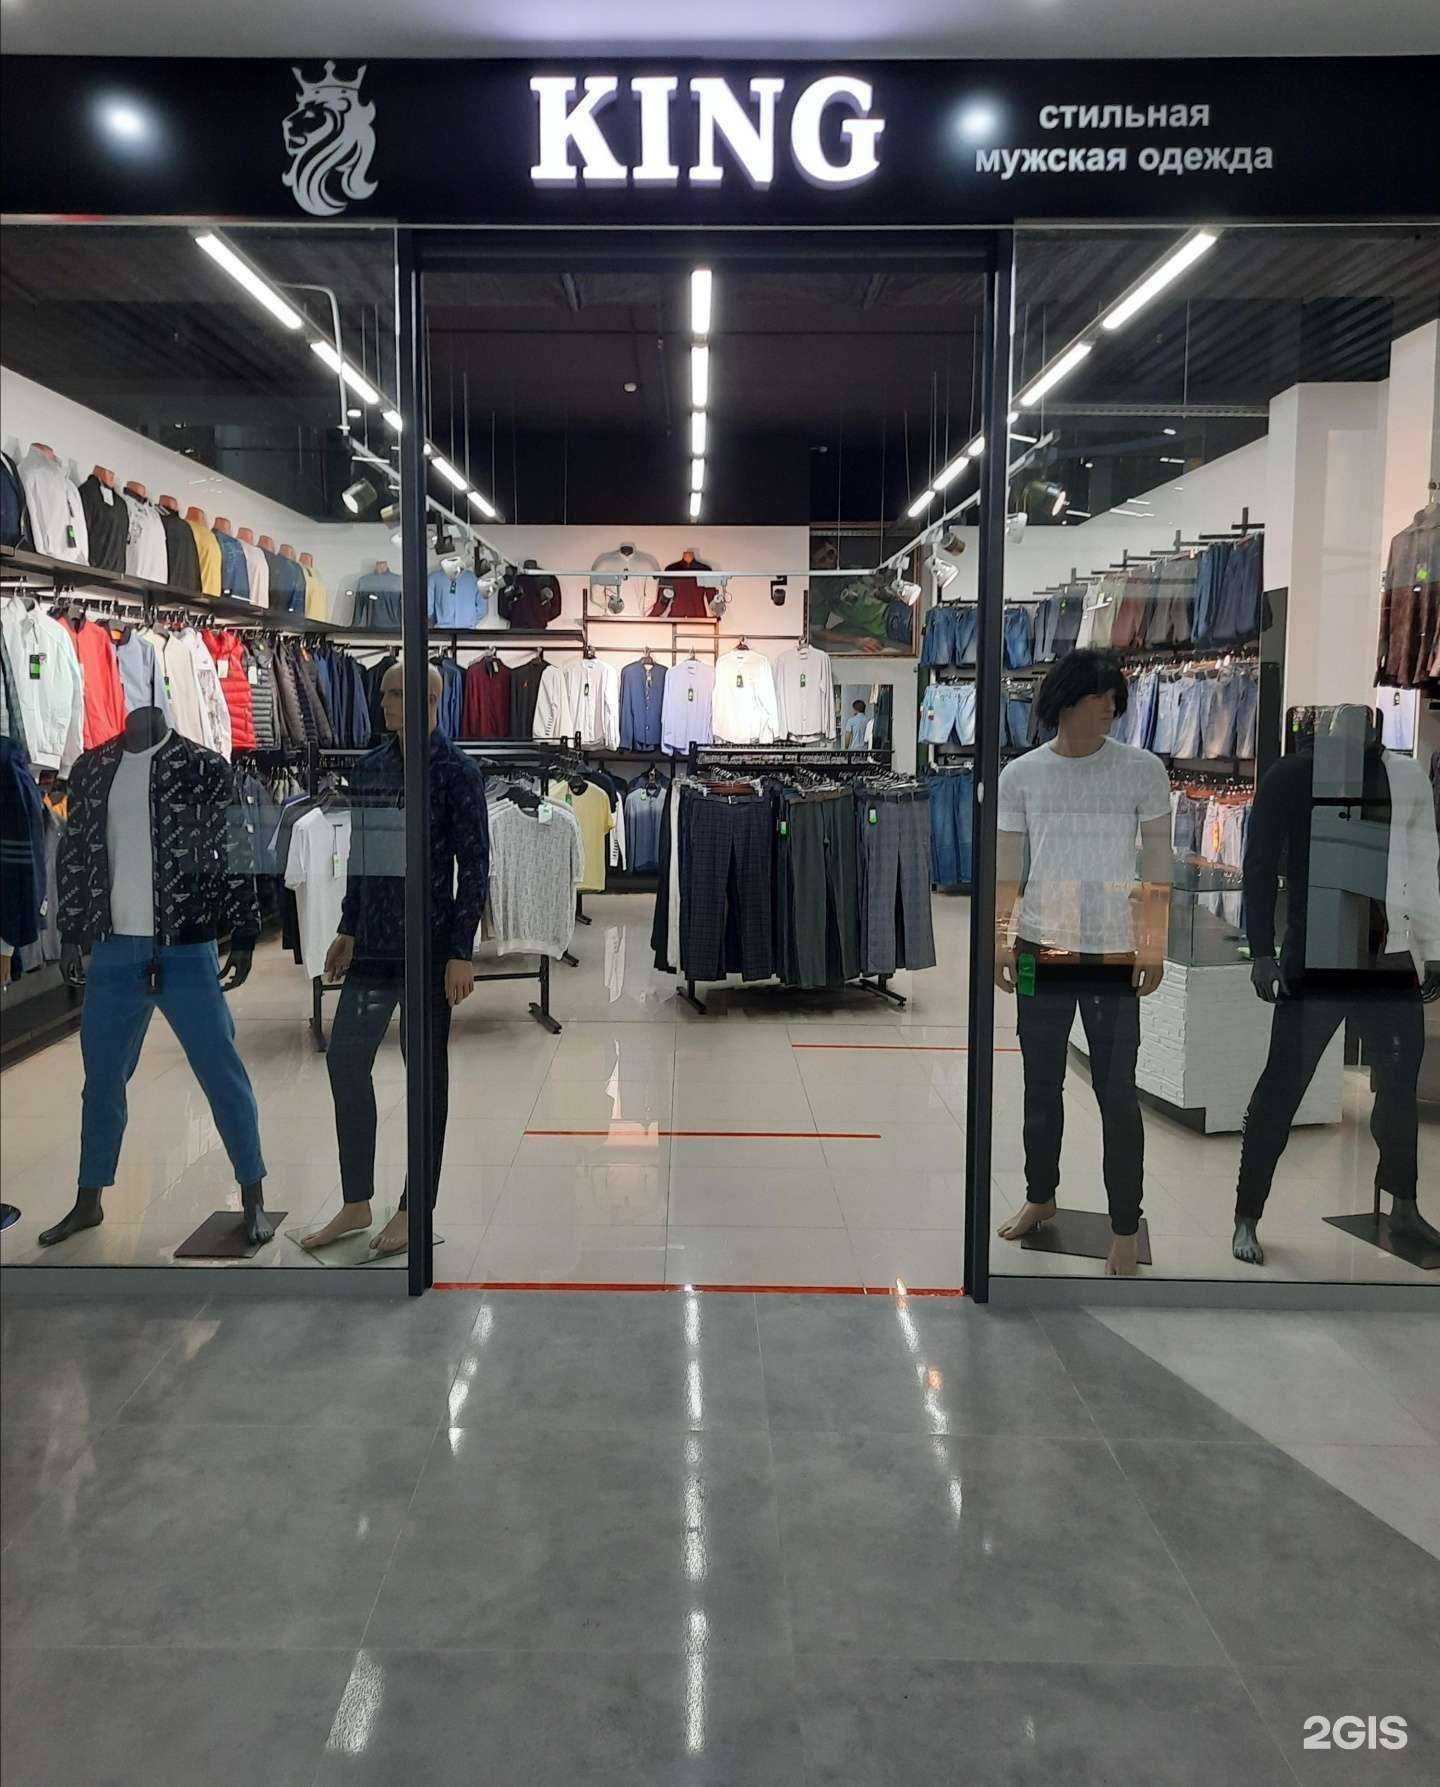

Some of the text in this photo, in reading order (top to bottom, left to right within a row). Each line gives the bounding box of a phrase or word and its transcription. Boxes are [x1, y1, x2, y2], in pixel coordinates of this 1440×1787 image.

[530, 75, 886, 189] KING
[1039, 104, 1210, 129] стильная
[975, 146, 1273, 180] мужская одежда
